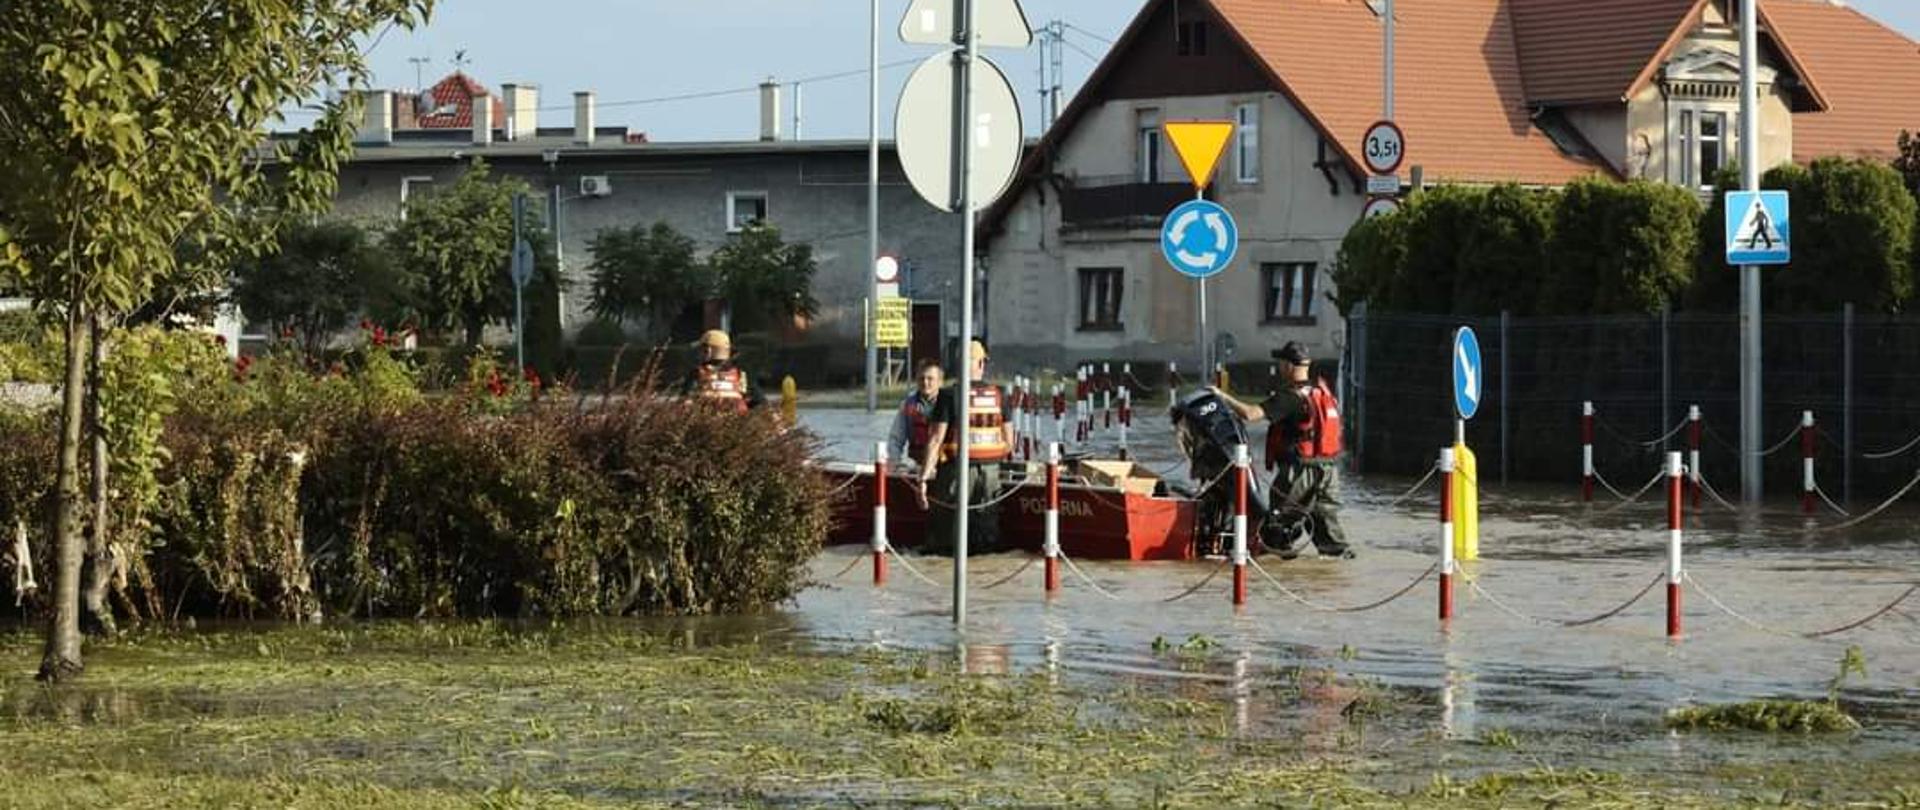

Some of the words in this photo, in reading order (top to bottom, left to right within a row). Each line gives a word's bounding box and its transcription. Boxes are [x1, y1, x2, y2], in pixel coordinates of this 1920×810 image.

[1369, 137, 1397, 158] 3,5t
[1200, 402, 1217, 416] 30
[1020, 498, 1094, 517] PORNA
